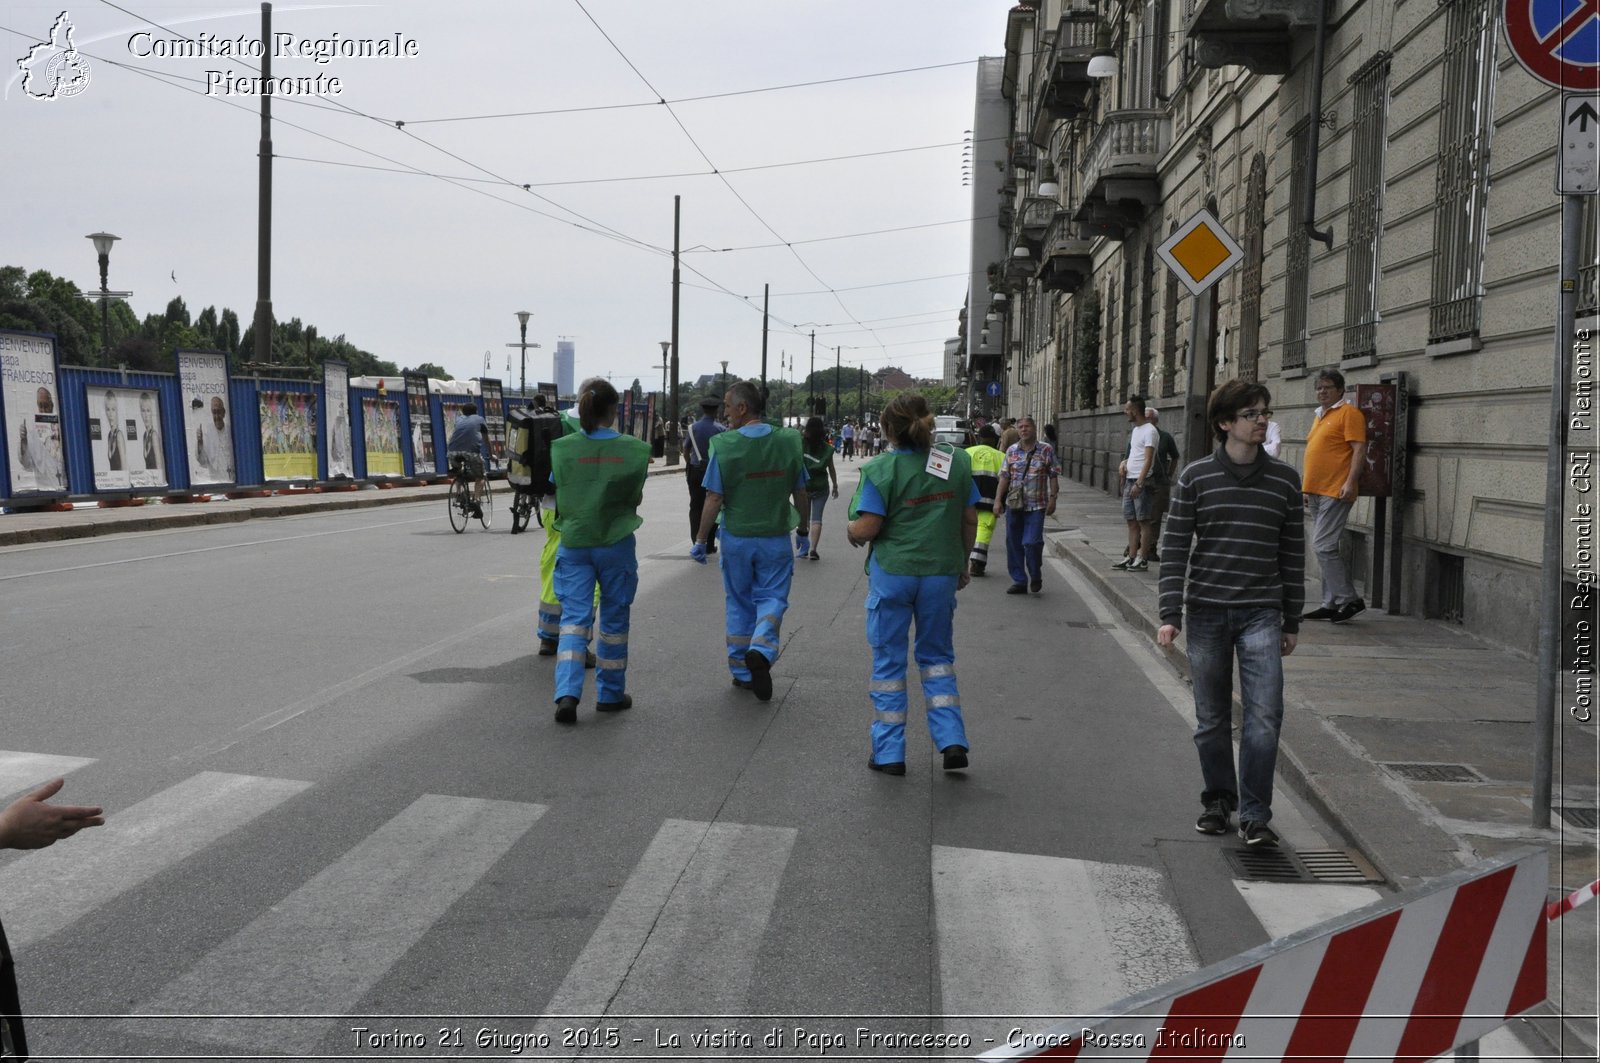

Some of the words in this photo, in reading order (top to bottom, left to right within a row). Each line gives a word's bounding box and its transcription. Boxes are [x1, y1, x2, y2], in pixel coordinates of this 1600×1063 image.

[0, 337, 51, 355] BENVENUTO
[179, 356, 224, 369] BENVENUTO
[2, 368, 54, 385] FRANCESCO
[181, 382, 226, 394] FRANCESCO
